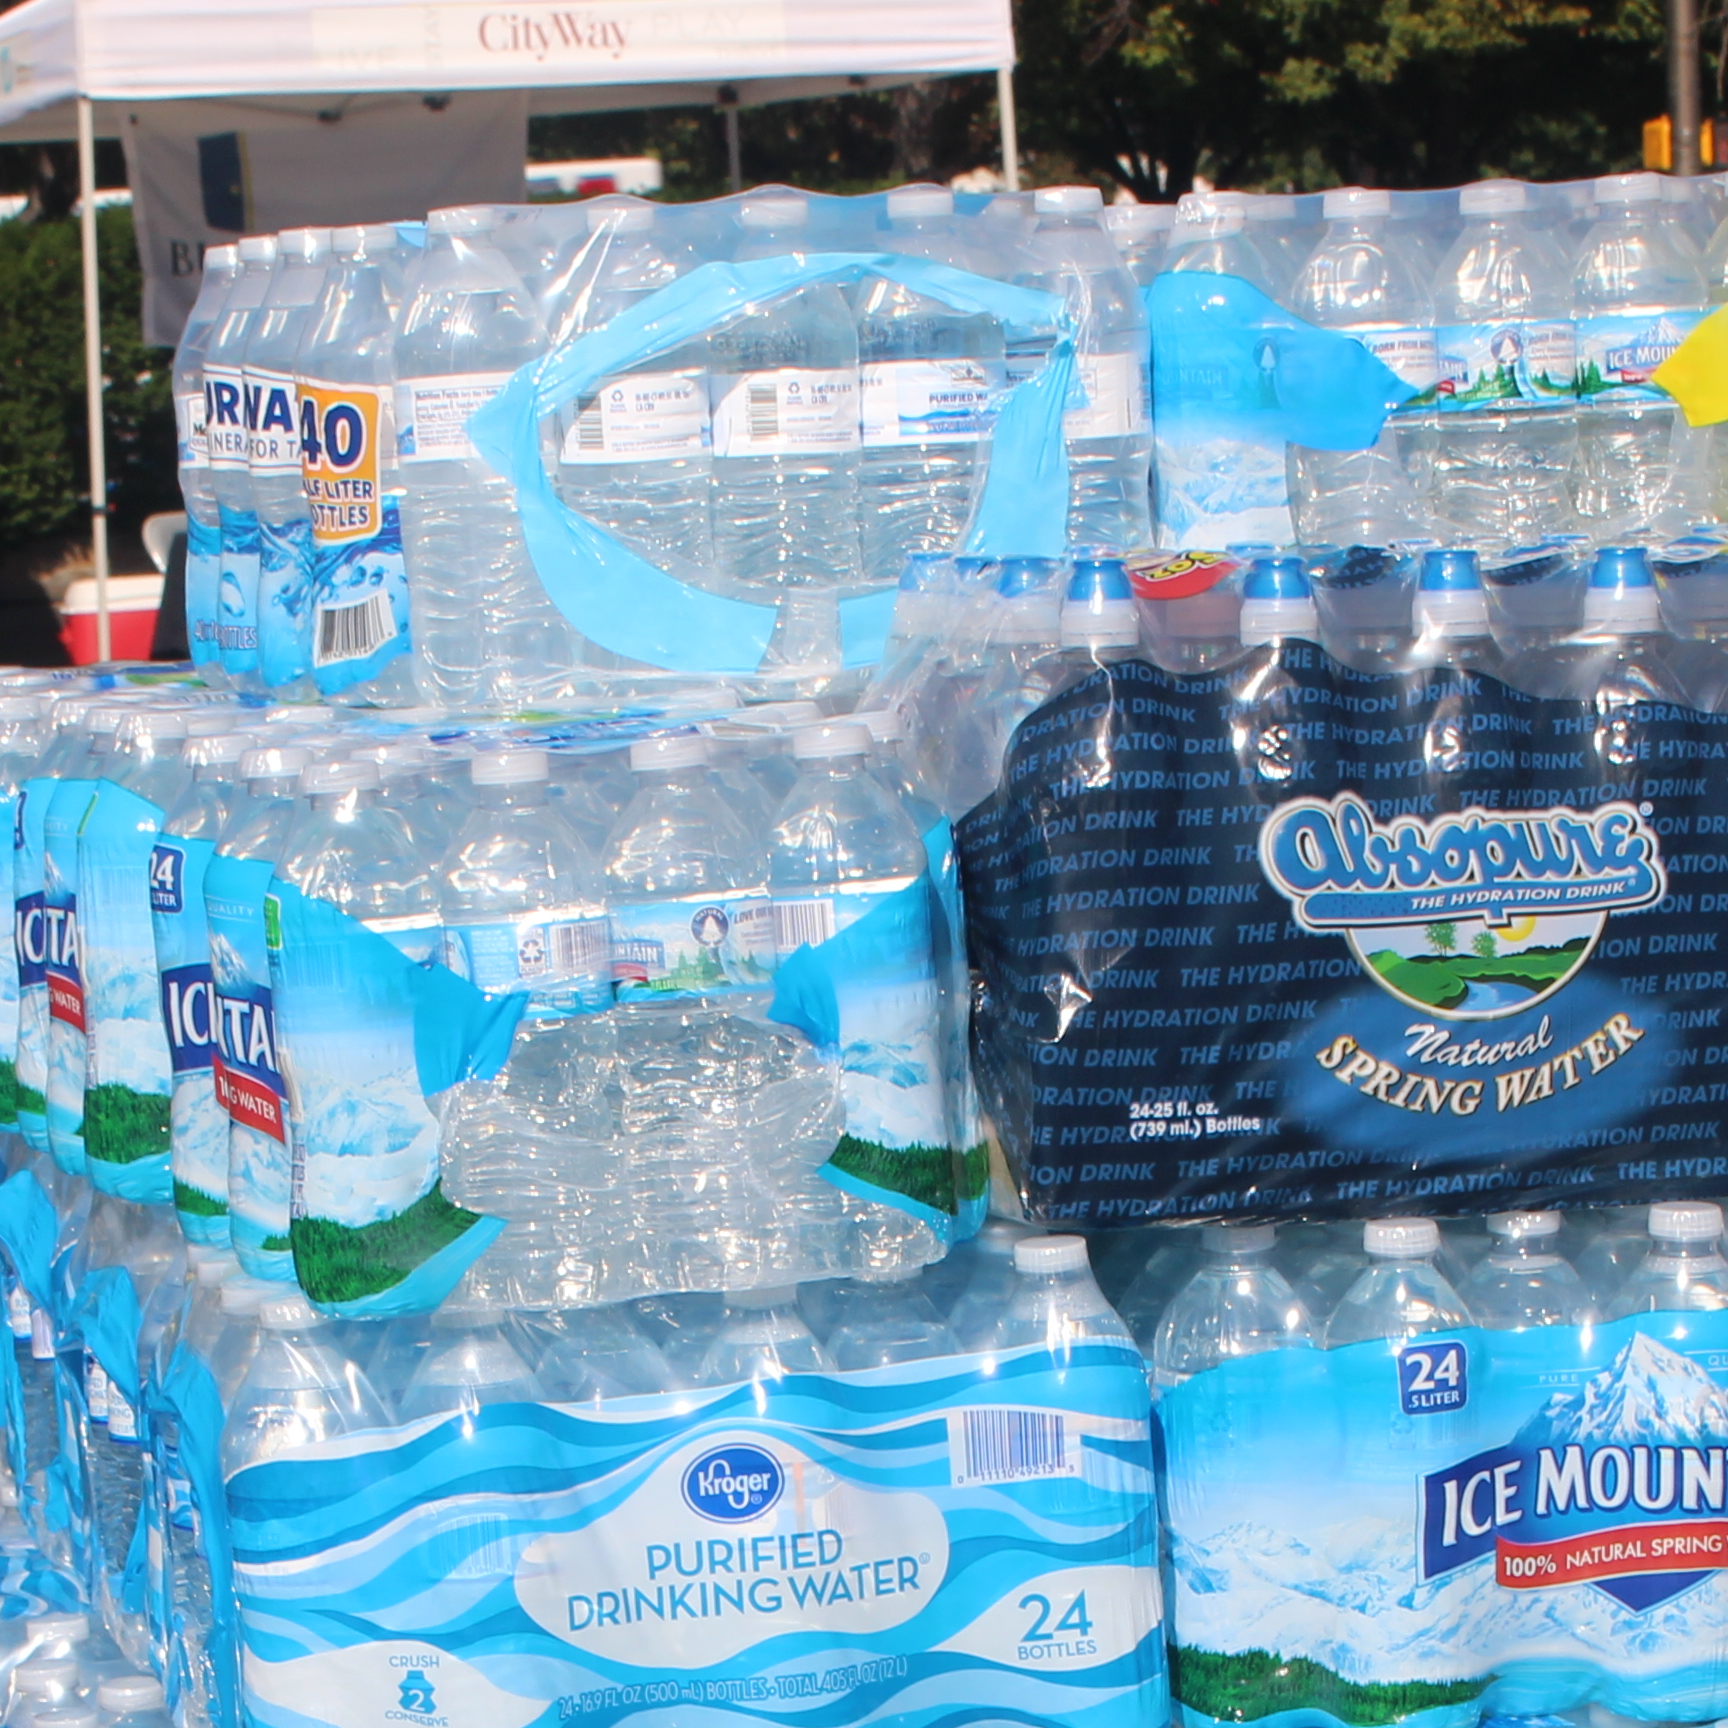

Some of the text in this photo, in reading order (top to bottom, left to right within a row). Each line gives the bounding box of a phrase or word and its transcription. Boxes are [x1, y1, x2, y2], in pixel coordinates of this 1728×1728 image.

[477, 11, 632, 61] CityWay
[1609, 349, 1634, 370] ICE
[302, 397, 364, 470] 40
[325, 479, 374, 501] LITER
[1473, 713, 1533, 735] DRINK
[1520, 749, 1585, 770] DRINK
[1643, 777, 1708, 799] DRINK
[1085, 809, 1158, 831] DRINK
[1143, 845, 1213, 868] DRINK
[1046, 884, 1260, 914] HYDRATION DRINK
[1411, 880, 1627, 911] THE HYDRATION DRINK
[1147, 924, 1214, 947] DRINK
[1649, 932, 1719, 954] DRINK
[1180, 958, 1362, 987] THE HYDRATION
[1102, 1000, 1317, 1029] HYDRATION DRINK
[1404, 1014, 1554, 1068] Natural
[1315, 1012, 1645, 1116] SPRING WATER
[240, 1091, 277, 1124] WATER
[1129, 1101, 1219, 1119] 24-25 fl. oz.
[1129, 1116, 1261, 1140] (739 ml.) Bottles
[1405, 1349, 1460, 1391] 24
[1539, 1373, 1579, 1384] PURE
[698, 1458, 771, 1510] Kroger
[1442, 1459, 1524, 1548] ICE
[645, 1528, 844, 1581] PURIFIED
[1504, 1552, 1557, 1578] 100%
[1566, 1541, 1648, 1570] NATURAL
[1651, 1534, 1723, 1558] SPRING
[568, 1554, 921, 1633] DRINKING WATER
[1019, 1588, 1094, 1643] 24
[388, 1655, 440, 1669] CRUSH
[1017, 1639, 1098, 1661] BOTTLES
[407, 1688, 426, 1712] 2
[707, 1678, 767, 1701] BOTTLES
[778, 1673, 820, 1700] TOTAL
[384, 1709, 449, 1728] CONSERVE
